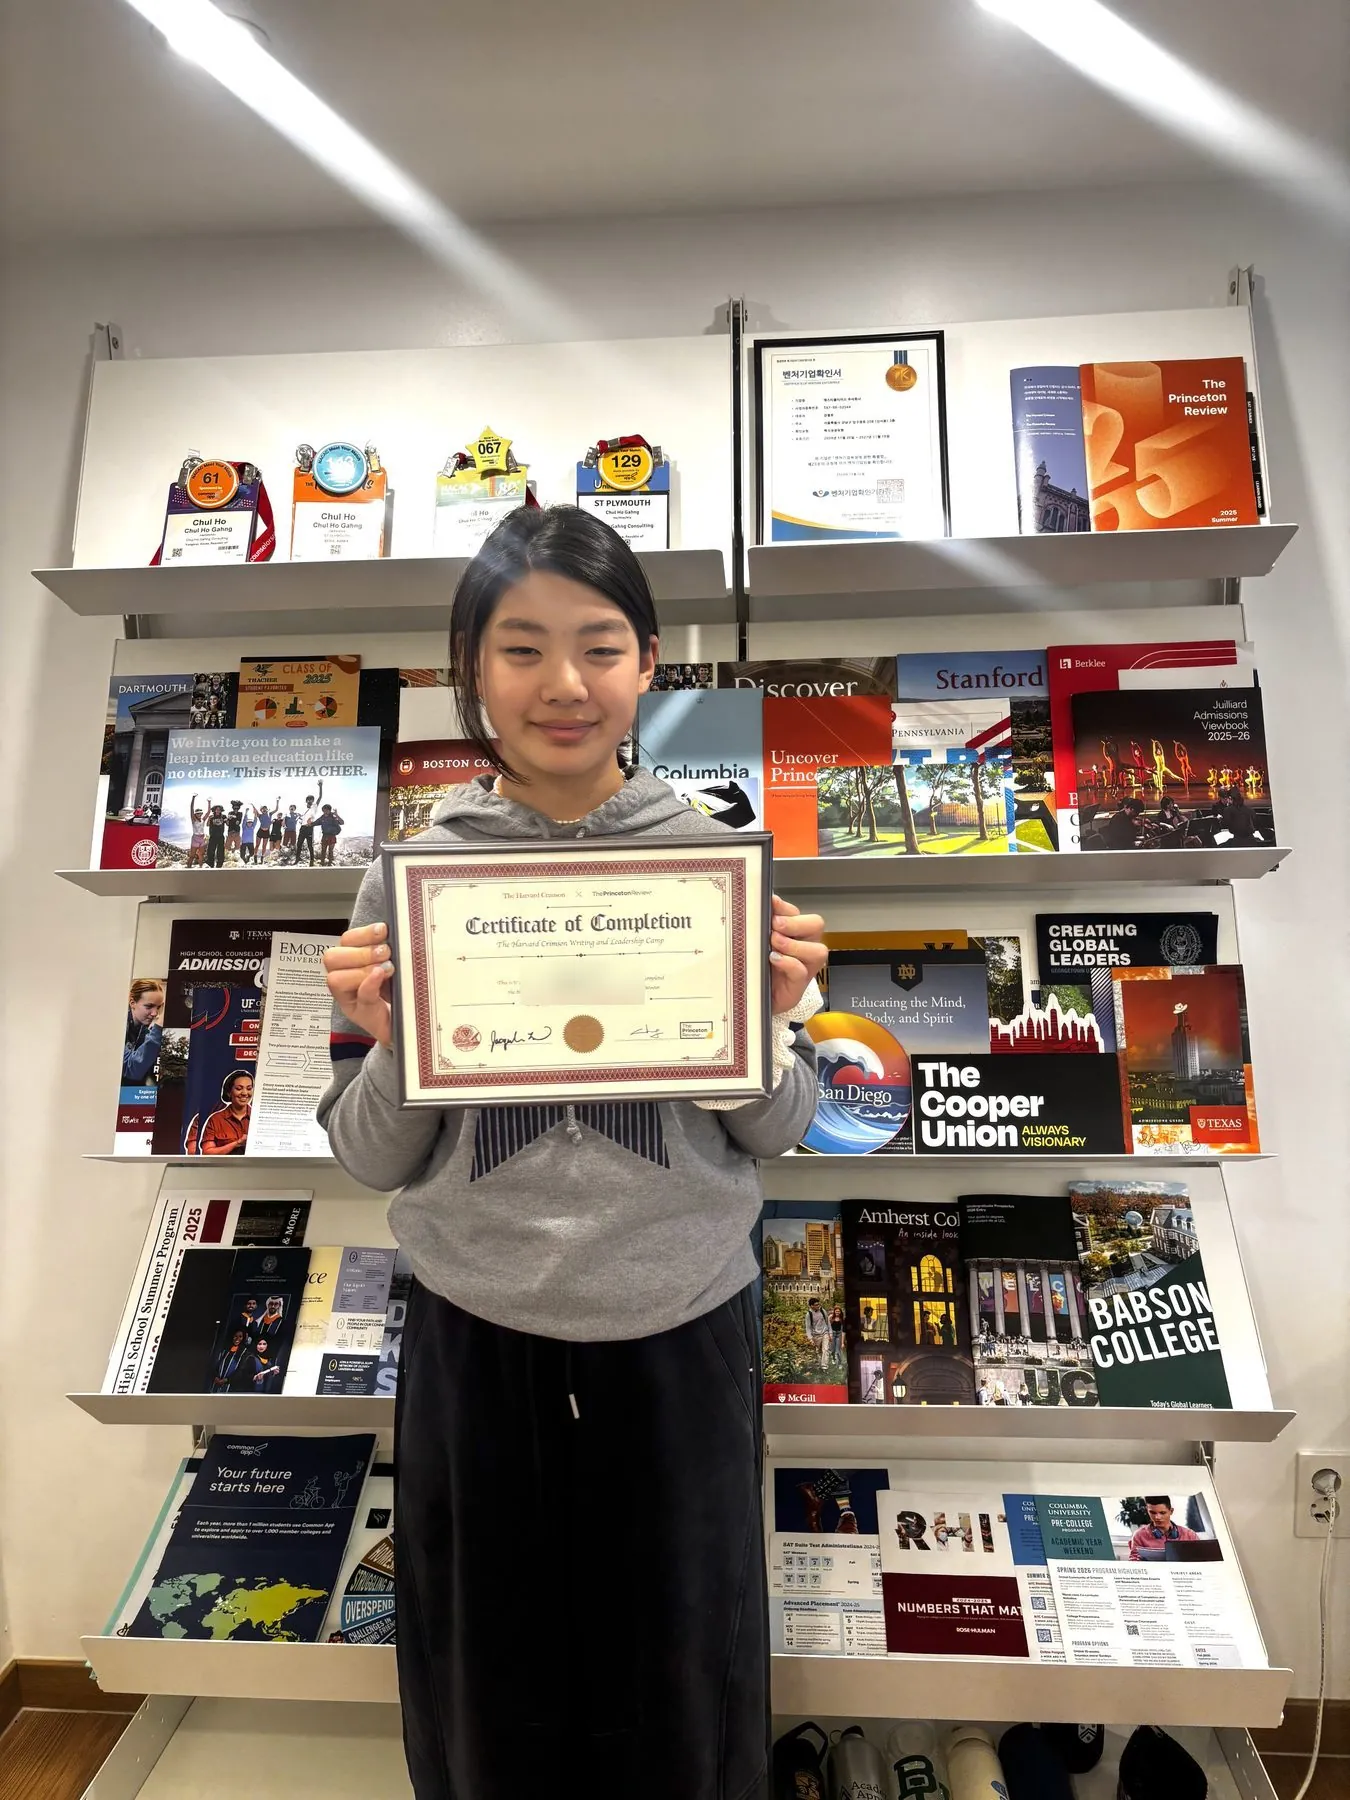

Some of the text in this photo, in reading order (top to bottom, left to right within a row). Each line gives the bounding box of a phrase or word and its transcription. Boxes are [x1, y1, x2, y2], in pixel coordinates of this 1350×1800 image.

[782, 369, 842, 379] 벤처기업확인서
[1202, 379, 1226, 389] The
[1168, 392, 1227, 403] Princeton
[1184, 405, 1228, 416] Review
[478, 442, 501, 454] 067
[612, 454, 642, 468] 129
[203, 472, 220, 484] 61
[283, 663, 333, 674] CLASS OF
[1075, 659, 1106, 668] Berklee
[303, 673, 333, 684] 2025
[936, 663, 1044, 690] Stanford
[119, 683, 186, 694] DARTMOUTH
[734, 677, 858, 697] Discover
[1212, 700, 1247, 709] Juilliard
[1193, 711, 1248, 720] Admissions
[1201, 721, 1249, 730] Viewbook
[892, 728, 965, 738] PENNSYLVANIA
[172, 735, 342, 750] We invite you to make a
[169, 749, 354, 766] leap into an education like
[771, 750, 839, 764] Uncover
[423, 760, 469, 769] BOSTON
[167, 765, 367, 780] no other. This is THACHER.
[653, 763, 749, 780] Columbia
[465, 912, 692, 935] Certificate of Completion
[1049, 924, 1137, 937] CREATING
[497, 940, 510, 948] The
[511, 940, 540, 948] Harvard
[541, 939, 568, 947] Crimson
[570, 939, 594, 948] Writing
[610, 938, 644, 946] Leadership
[646, 937, 664, 945] Camp
[1050, 940, 1120, 952] GLOBAL
[280, 942, 335, 956] EMOR
[1050, 954, 1131, 966] LEADERS
[851, 997, 966, 1011] Educating the Mind,
[865, 1012, 953, 1026] Body, and Spirit
[918, 1062, 980, 1088] The
[818, 1082, 892, 1106] San Diego
[920, 1091, 1045, 1122] Cooper
[1207, 1119, 1242, 1128] TEXAS
[921, 1120, 1018, 1147] Union
[1022, 1126, 1069, 1136] ALWAYS
[1022, 1137, 1086, 1147] VISIONARY
[858, 1209, 960, 1227] Amherst Col
[183, 1208, 202, 1242] 2025
[282, 1208, 301, 1245] & MORE
[898, 1228, 959, 1239] An inside look
[117, 1364, 135, 1394] High
[127, 1317, 149, 1360] School
[140, 1262, 164, 1314] Summer
[156, 1207, 179, 1258] Program
[1089, 1281, 1213, 1331] BABSON
[1090, 1318, 1221, 1369] COLLEGE
[788, 1394, 816, 1402] McGill
[1150, 1400, 1170, 1408] Today's
[1170, 1400, 1188, 1408] Global
[217, 1467, 292, 1480] Your future
[209, 1482, 285, 1493] starts here
[1051, 1519, 1093, 1528] PRE-COLLEGE
[896, 1510, 1006, 1553] RHI
[1051, 1538, 1102, 1546] ACADEMIC YEAR
[1063, 1546, 1094, 1555] WEEKEND
[1056, 1566, 1076, 1574] SPRING
[350, 1569, 394, 1592] STRUGGLING IN
[345, 1600, 395, 1624] OVERSPEND
[897, 1602, 960, 1614] NUMBERS
[963, 1604, 994, 1615] THAT
[349, 1621, 385, 1642] CHALLENGES
